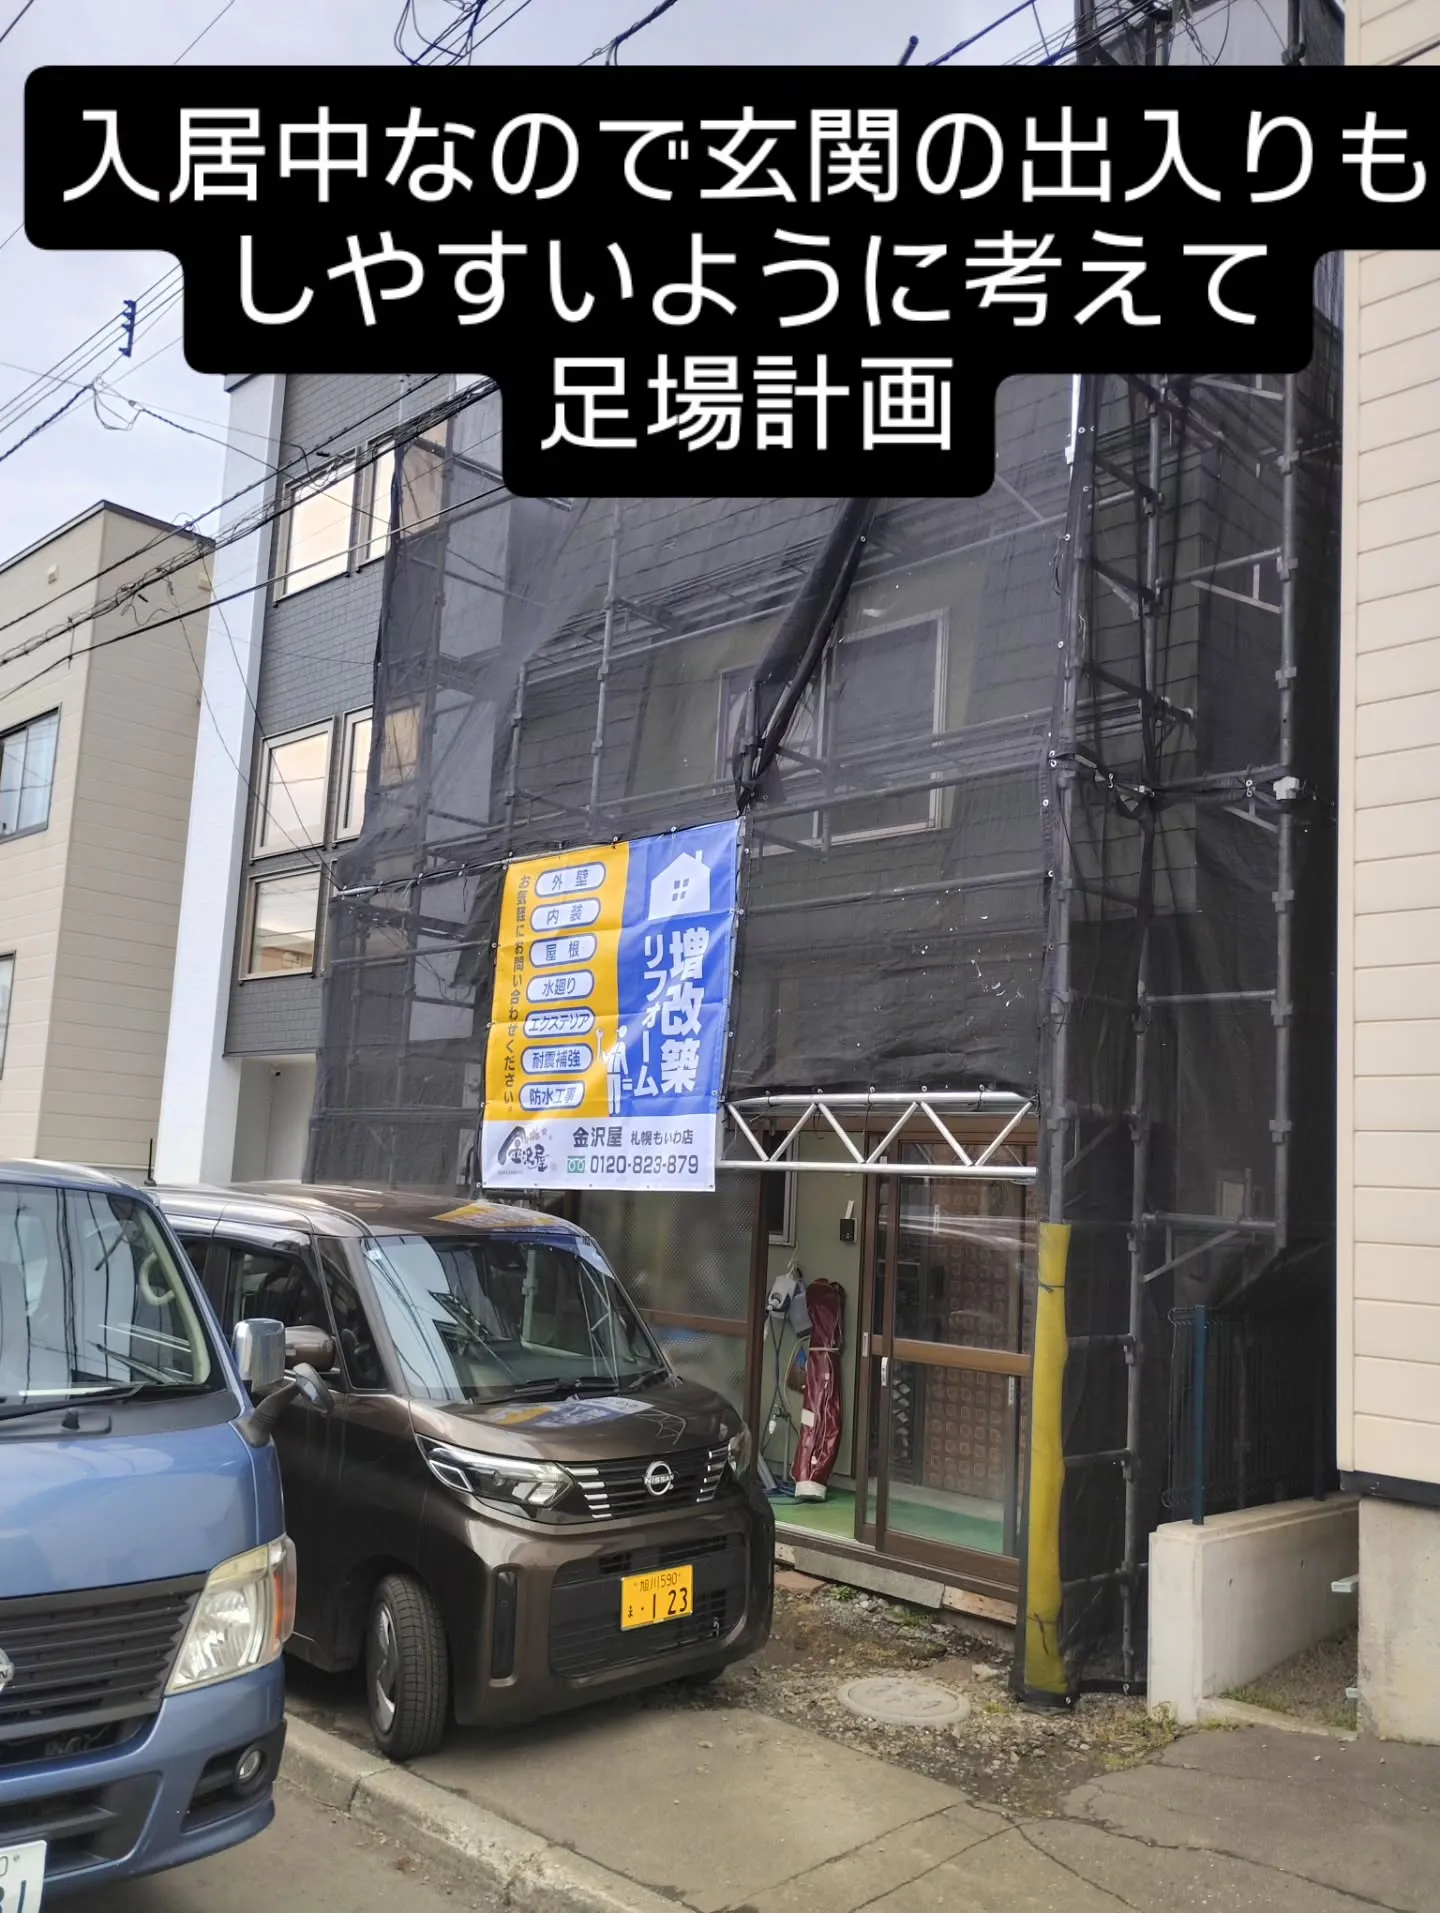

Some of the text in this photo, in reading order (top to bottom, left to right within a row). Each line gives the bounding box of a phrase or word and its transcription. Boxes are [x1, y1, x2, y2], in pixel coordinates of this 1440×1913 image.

[542, 977, 576, 997] 水廻り
[633, 933, 668, 1097] リフォーム
[660, 926, 709, 1094] 増改築
[528, 1013, 590, 1032] エクステリア
[532, 1049, 581, 1069] 耐震補強
[529, 1087, 576, 1105] 防水工事
[573, 1126, 623, 1148] 金沢屋
[630, 1129, 694, 1146] 札幌もいわ店
